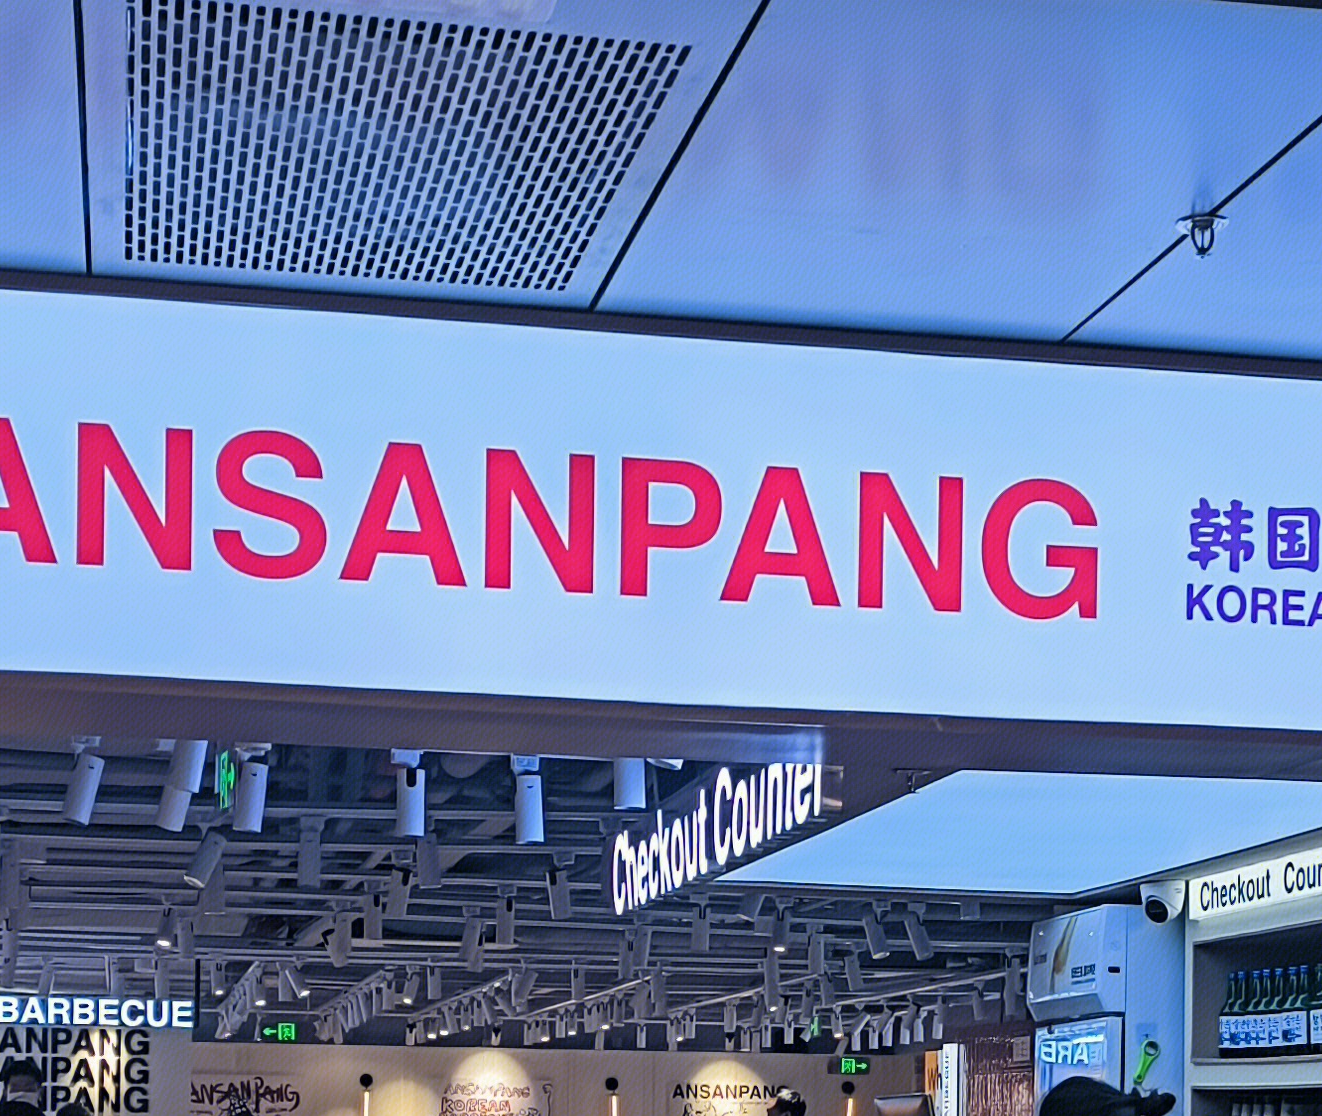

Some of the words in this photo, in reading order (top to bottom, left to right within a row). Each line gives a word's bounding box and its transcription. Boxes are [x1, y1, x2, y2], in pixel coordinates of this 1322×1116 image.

[613, 788, 708, 915] Checkout
[1200, 868, 1271, 912] Checkout
[673, 1083, 789, 1099] ANSANPAN
